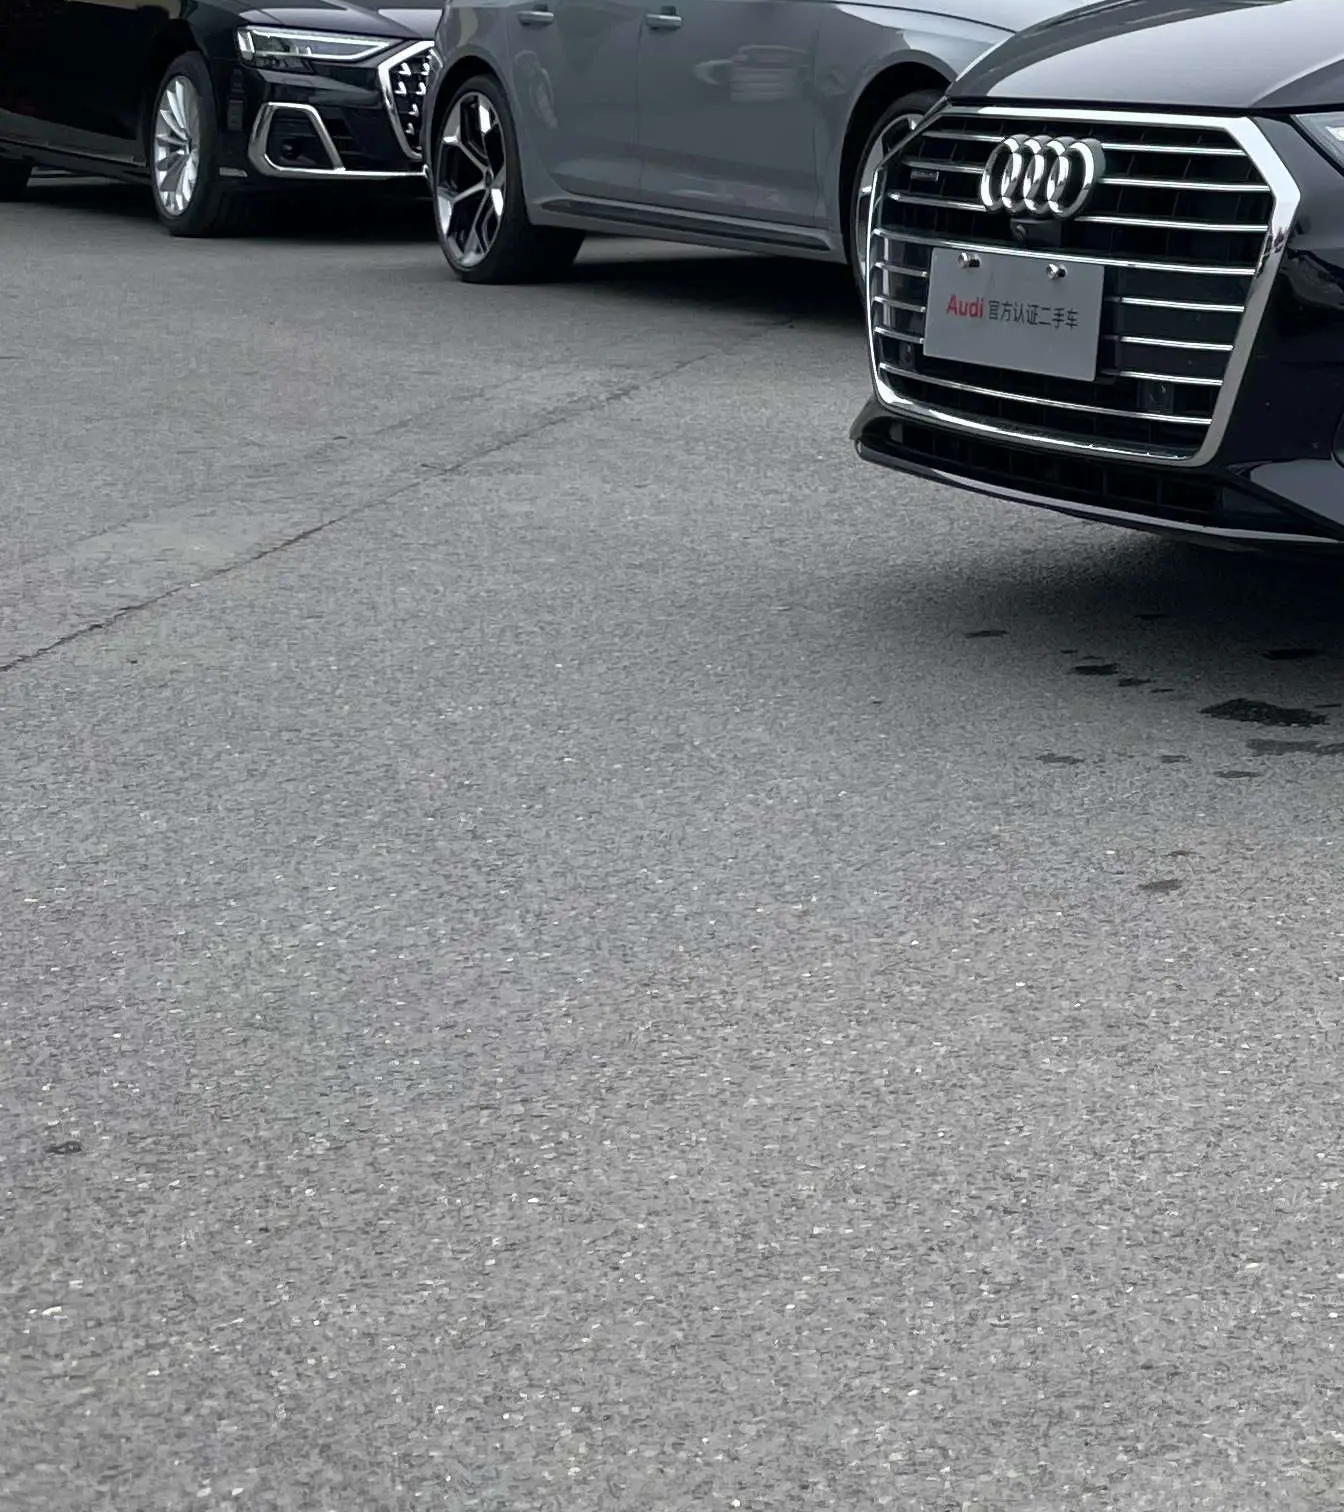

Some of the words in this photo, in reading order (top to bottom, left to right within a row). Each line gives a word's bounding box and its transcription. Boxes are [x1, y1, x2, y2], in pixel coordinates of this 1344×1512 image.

[946, 292, 985, 319] Audi
[988, 299, 1079, 331] 官方认证二手车
